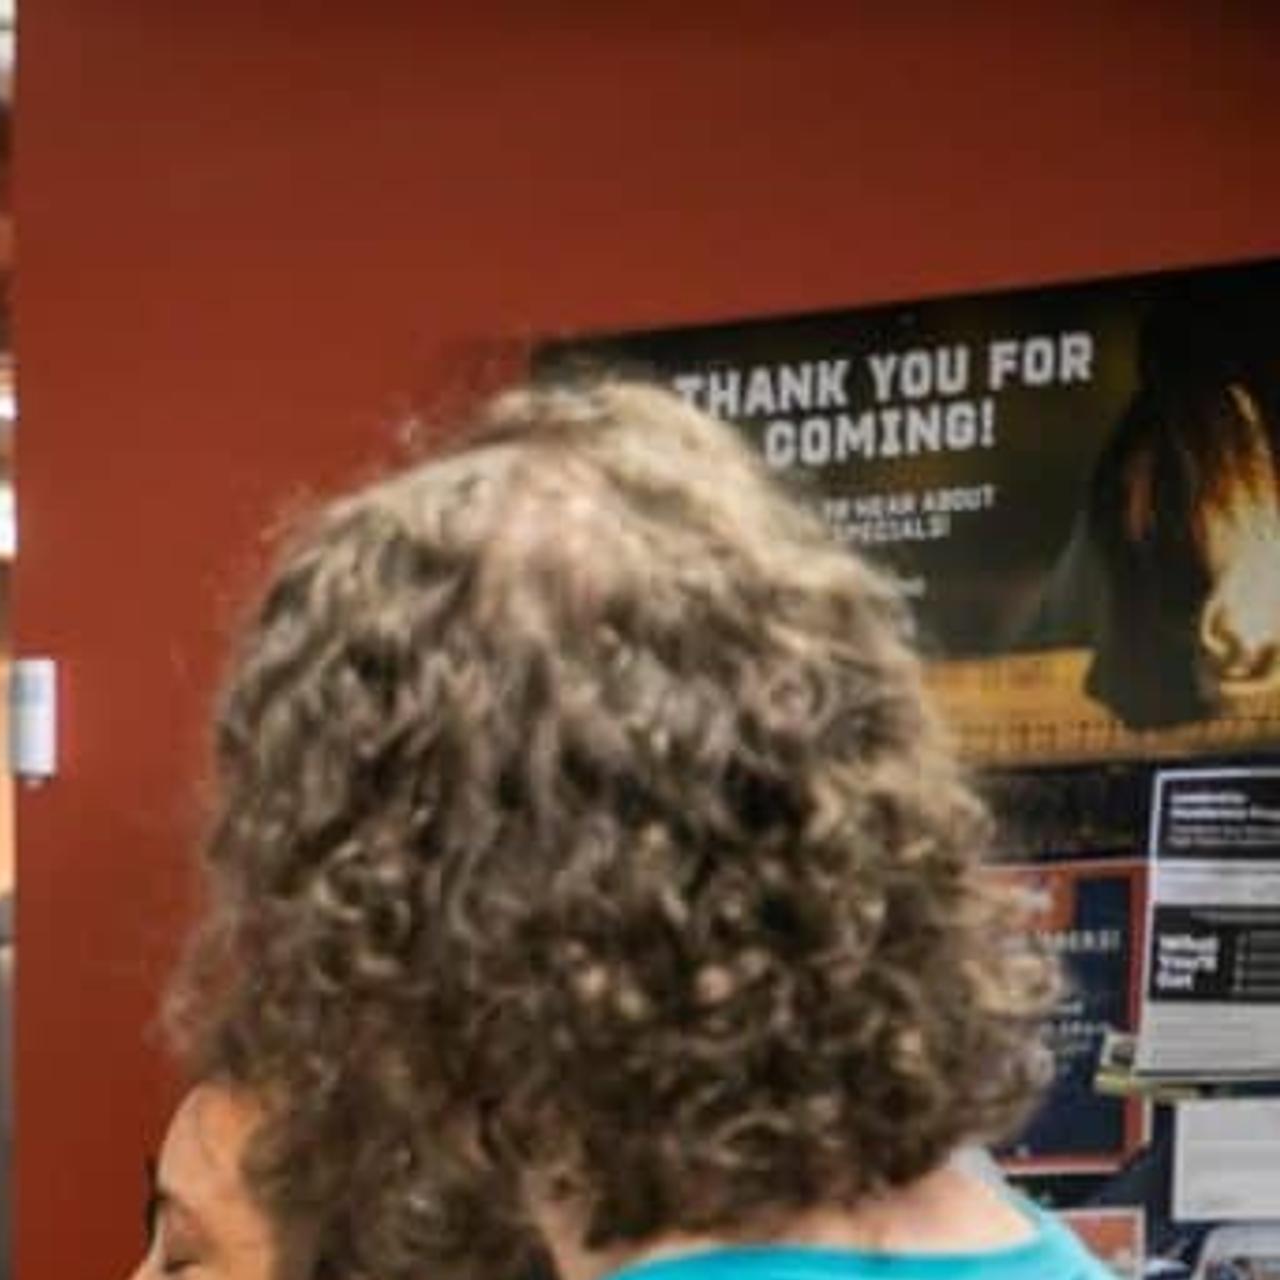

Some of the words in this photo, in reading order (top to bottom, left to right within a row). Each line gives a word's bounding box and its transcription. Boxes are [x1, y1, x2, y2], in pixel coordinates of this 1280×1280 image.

[674, 359, 849, 419] THANK
[868, 345, 971, 401] YOU
[989, 332, 1095, 391] FOR
[764, 400, 996, 468] COMING!
[922, 483, 995, 513] ABOUT
